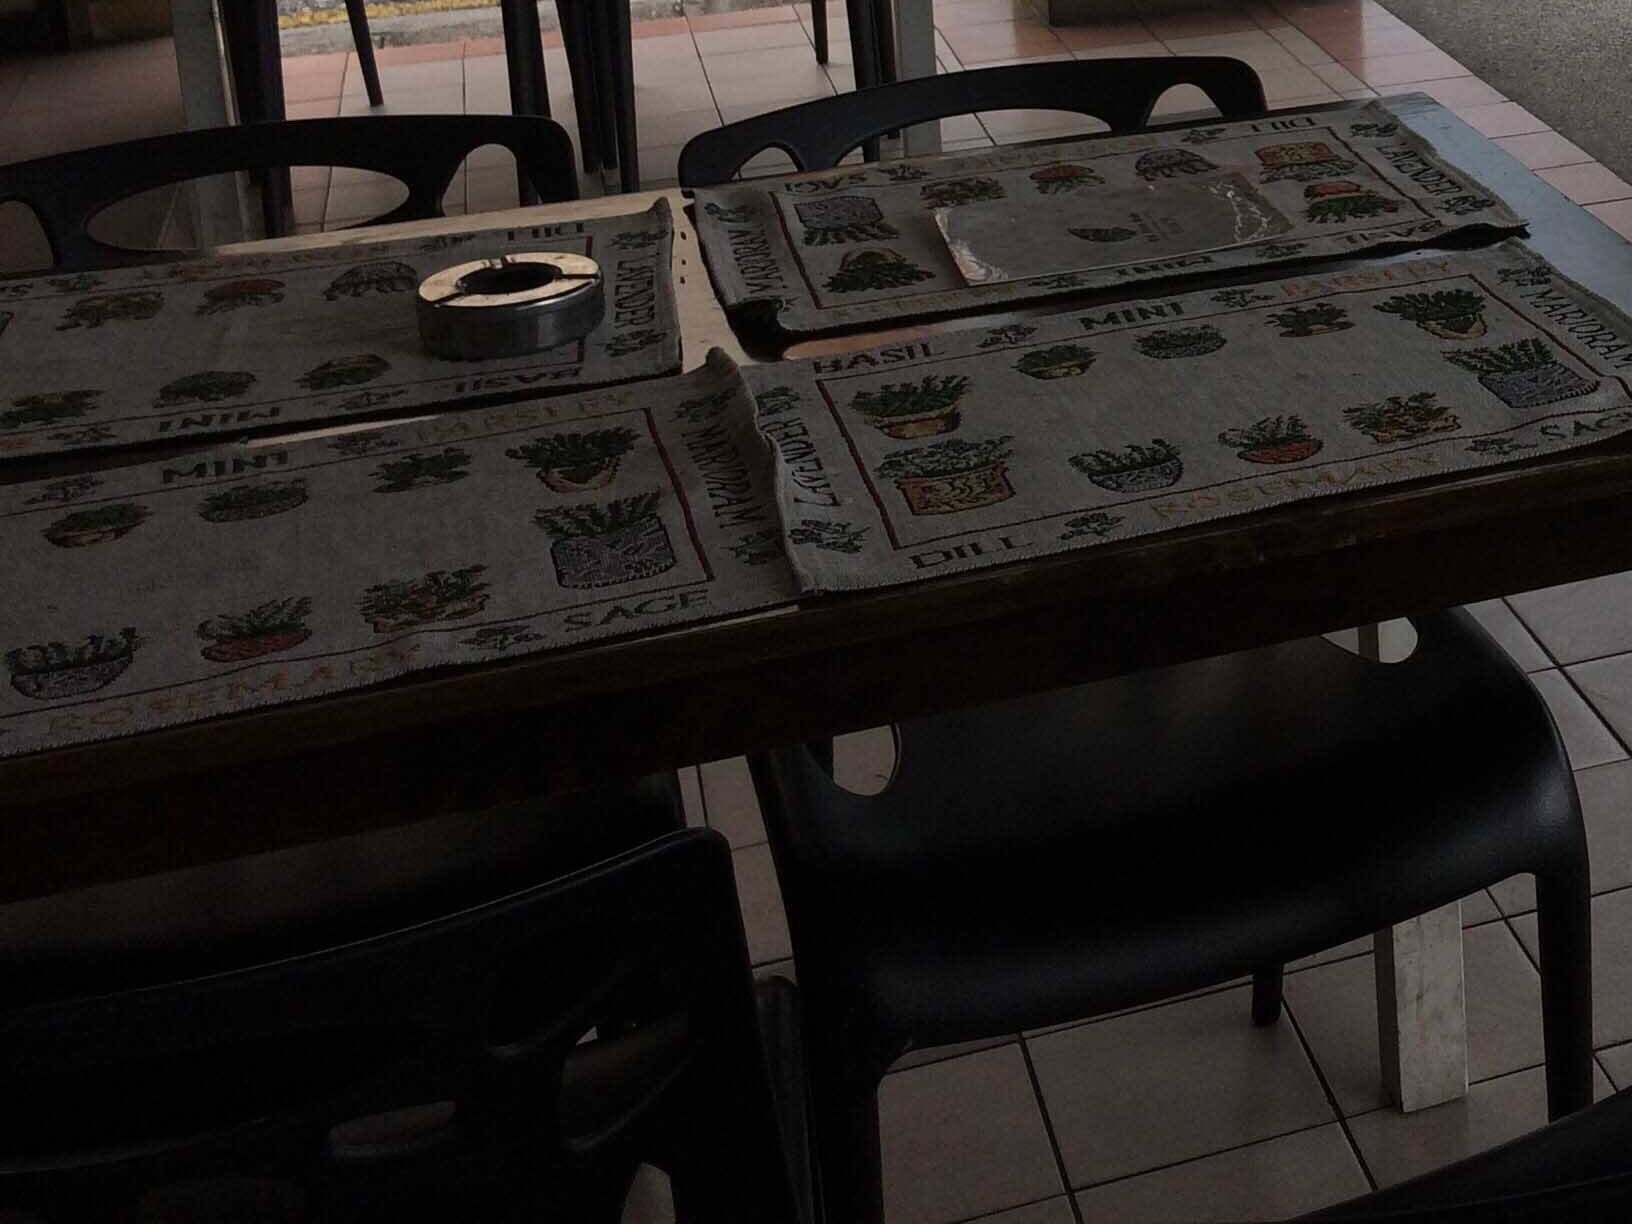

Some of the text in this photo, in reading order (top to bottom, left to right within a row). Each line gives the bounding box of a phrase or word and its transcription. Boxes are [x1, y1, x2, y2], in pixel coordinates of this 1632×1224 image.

[1079, 301, 1186, 331] MINT
[815, 342, 946, 374] BASIL
[162, 451, 289, 483] MINT
[908, 535, 1034, 569] DILL
[564, 588, 713, 633] SAGE
